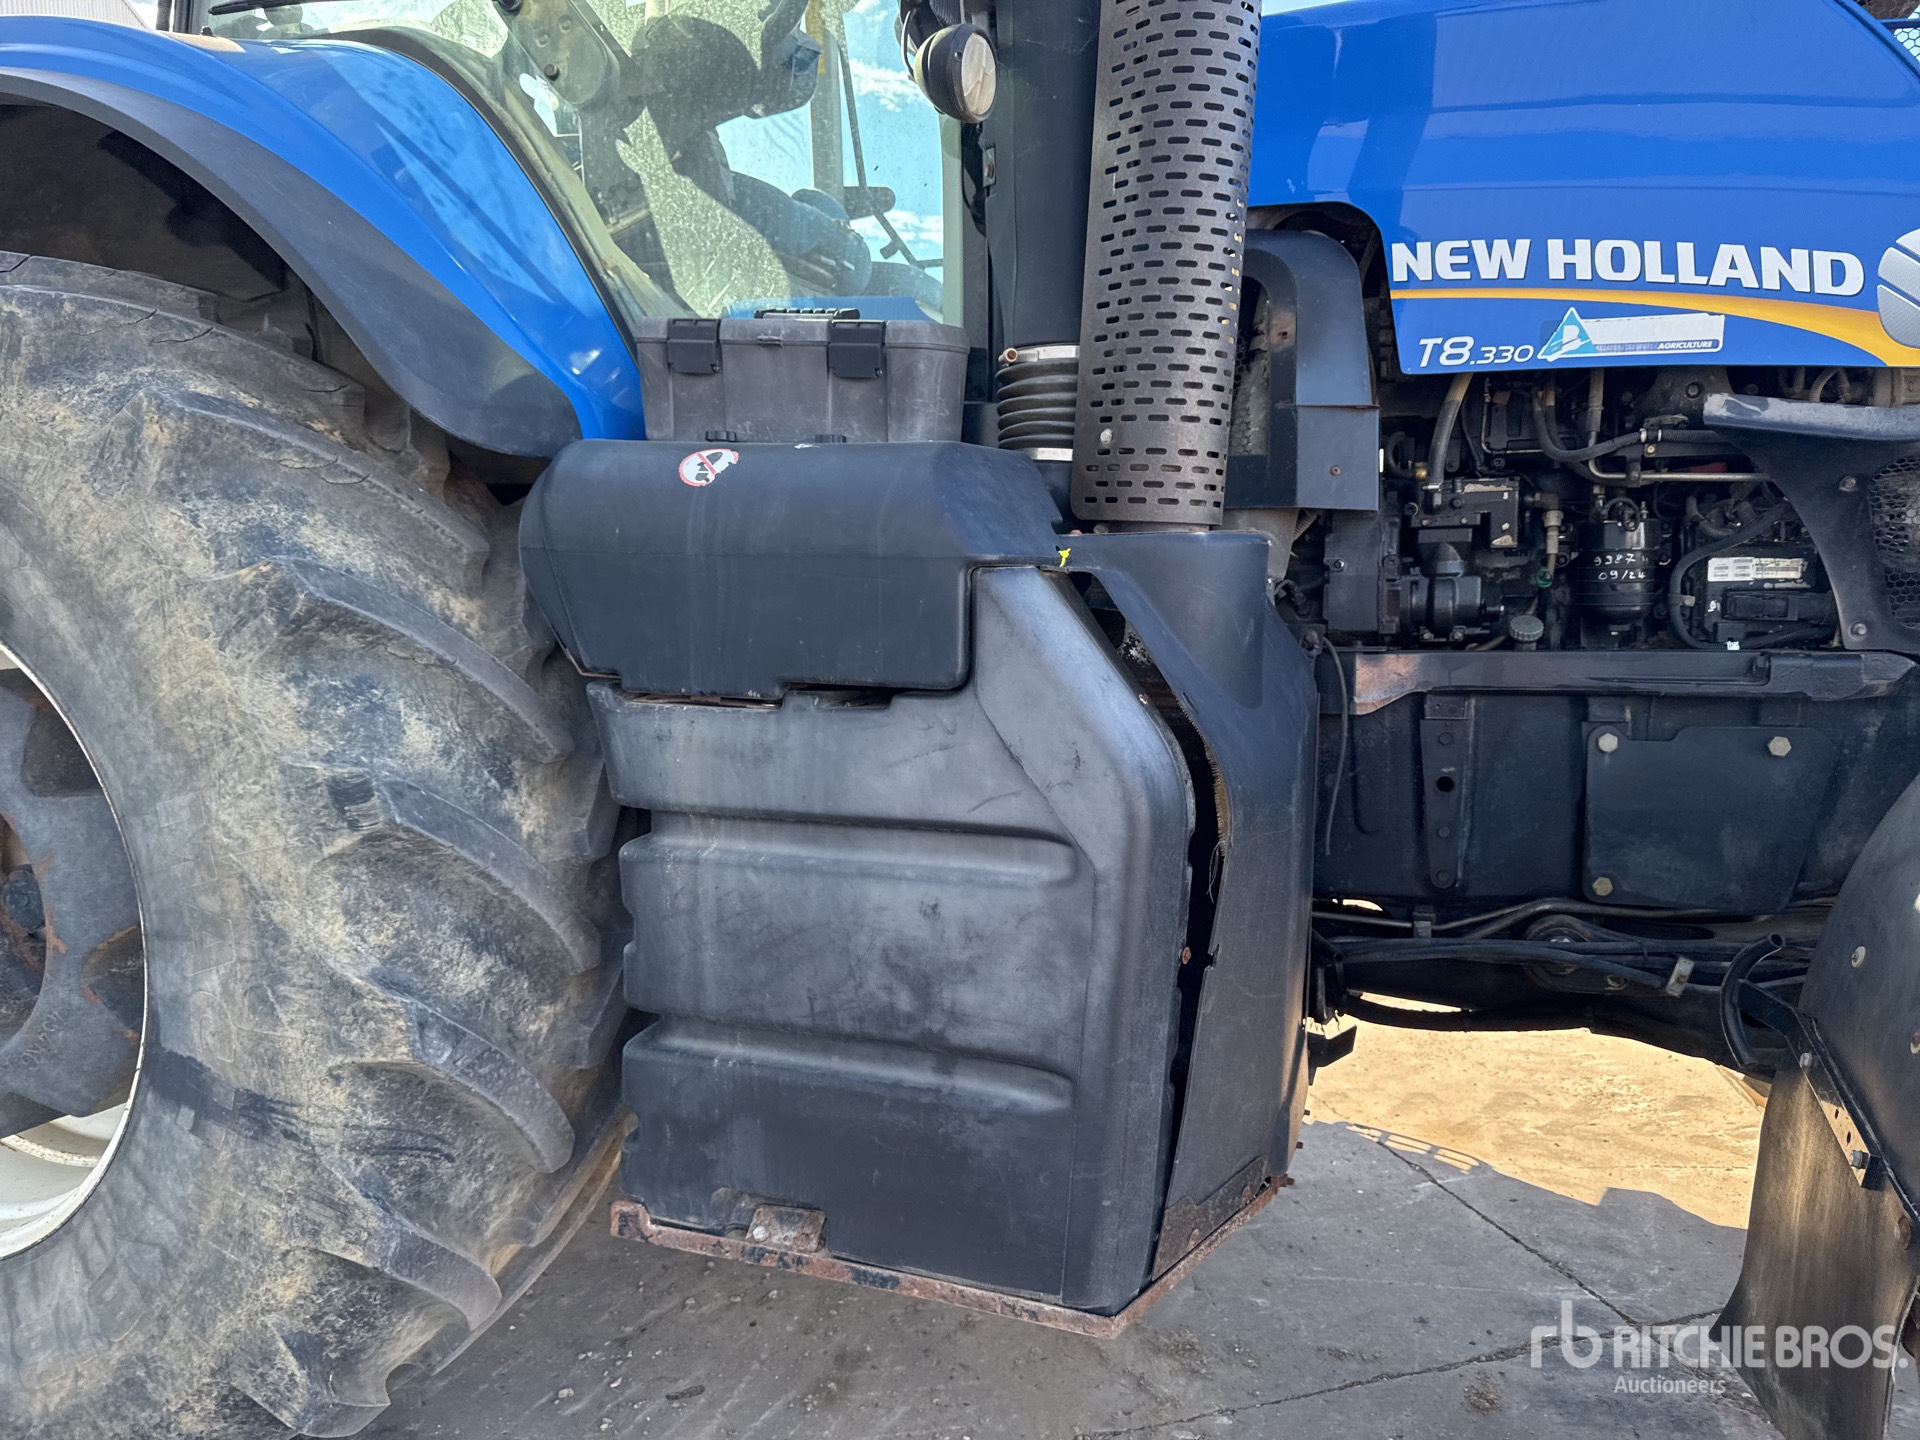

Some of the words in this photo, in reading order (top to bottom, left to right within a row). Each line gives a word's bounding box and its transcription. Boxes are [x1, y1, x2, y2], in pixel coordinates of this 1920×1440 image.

[1390, 238, 1531, 282] NEW
[1547, 238, 1865, 296] HOLLAND
[1419, 336, 1535, 368] T8.330
[1657, 340, 1713, 350] AGRICULTURE
[1598, 569, 1646, 580] 09/24
